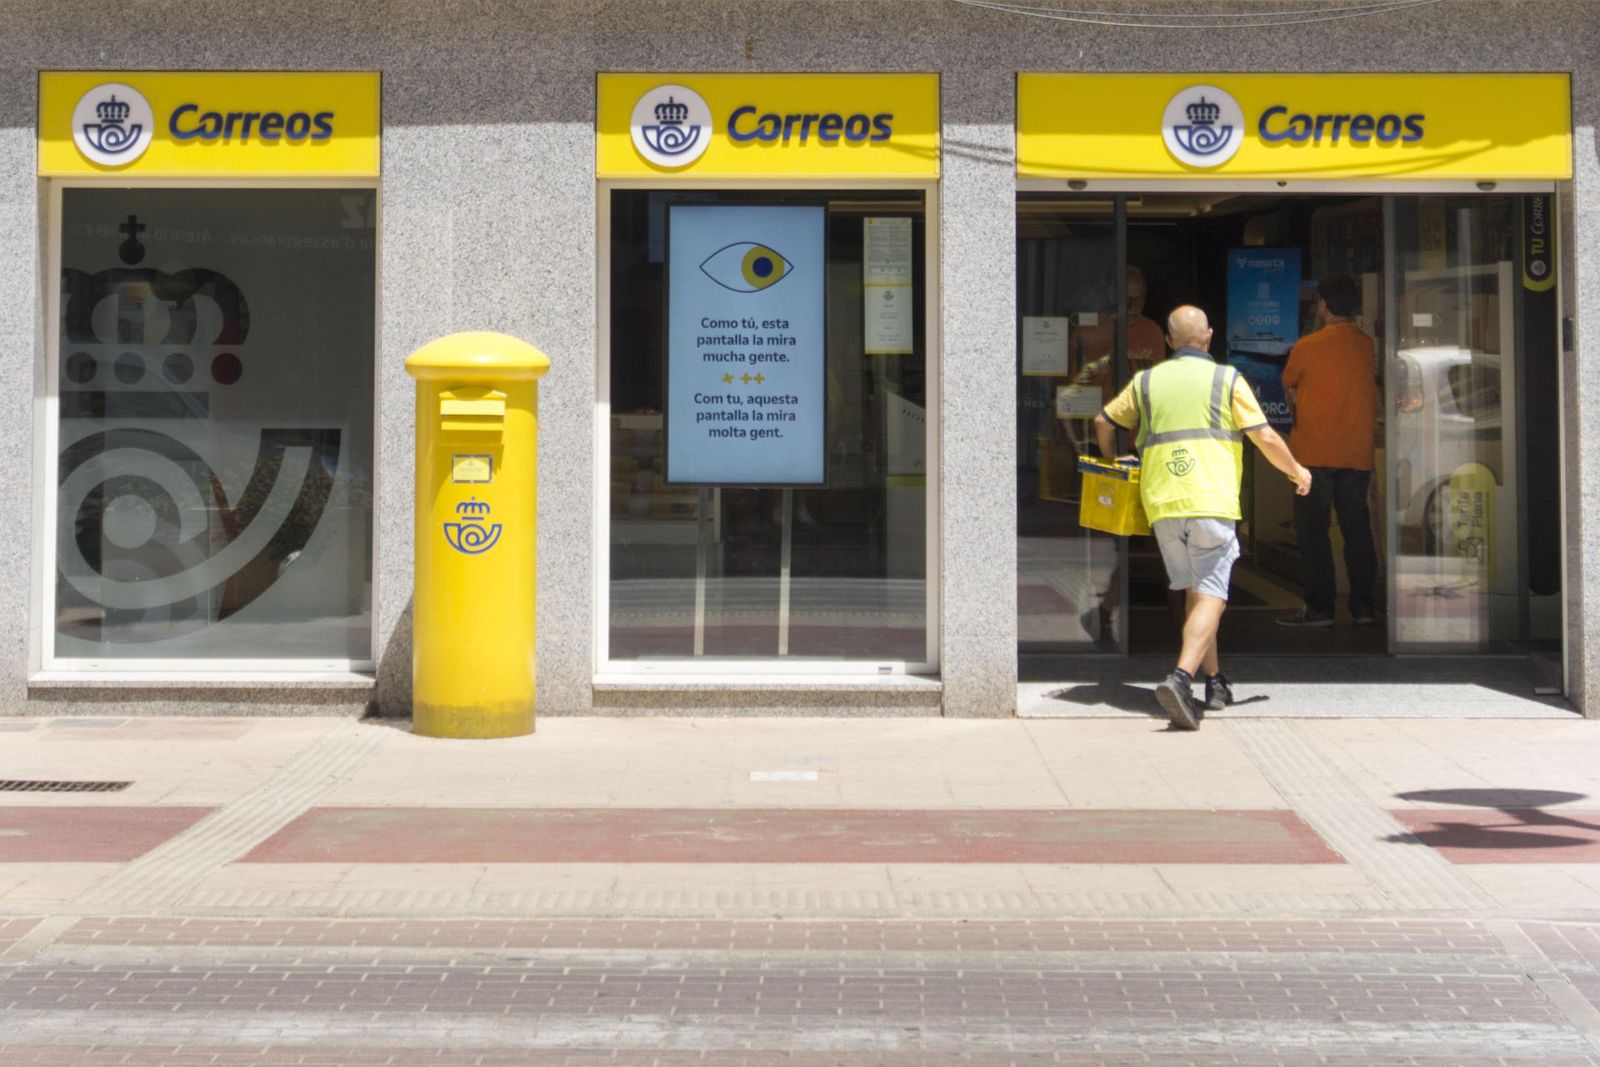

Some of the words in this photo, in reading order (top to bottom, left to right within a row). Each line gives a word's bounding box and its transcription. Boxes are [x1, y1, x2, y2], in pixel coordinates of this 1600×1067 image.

[168, 103, 334, 140] Correos
[727, 104, 894, 142] Correos
[1258, 104, 1425, 142] Correos
[1531, 238, 1545, 255] TU
[701, 317, 738, 329] Como
[742, 317, 759, 331] tú,
[762, 318, 790, 329] esta
[697, 334, 750, 348] pantalla
[752, 334, 764, 346] la
[767, 334, 797, 346] mira
[703, 351, 746, 362] mucha
[749, 352, 790, 365] gente.
[694, 393, 723, 405] Com
[727, 394, 744, 406] tu,
[747, 395, 799, 407] aquesta
[696, 410, 749, 424] pantalla
[752, 410, 764, 421] la
[766, 409, 796, 421] mira
[708, 426, 746, 438] molta
[750, 427, 784, 441] gent.
